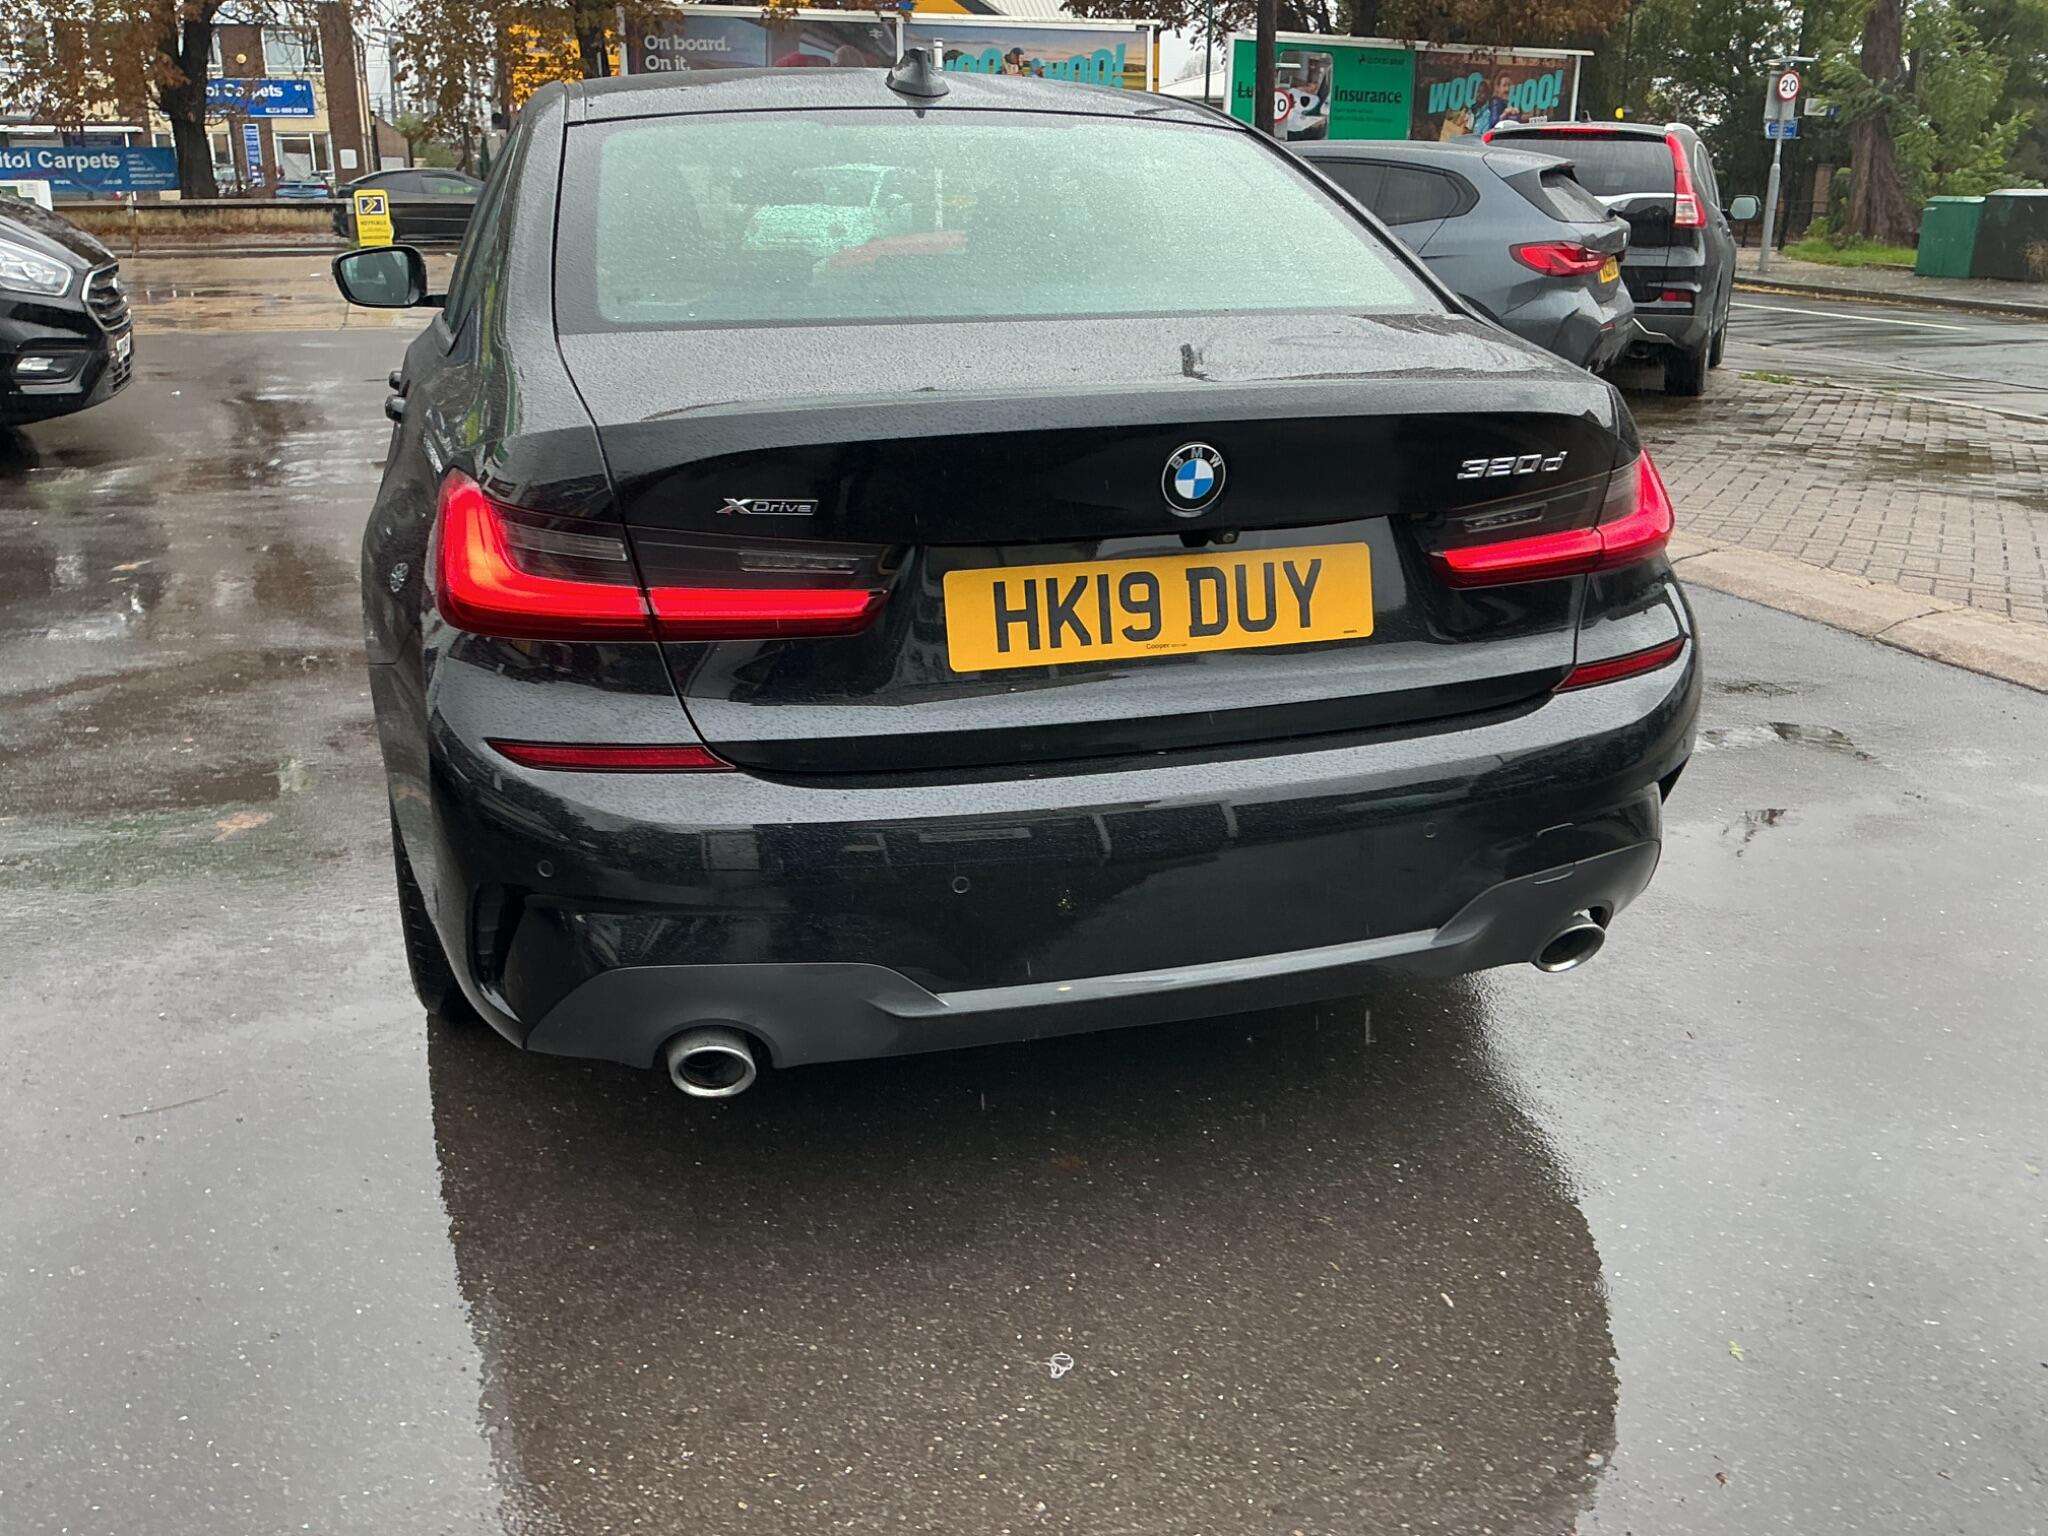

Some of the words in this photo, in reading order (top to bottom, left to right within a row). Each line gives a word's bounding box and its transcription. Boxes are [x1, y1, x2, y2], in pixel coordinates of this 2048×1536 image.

[644, 35, 670, 51] On
[673, 35, 731, 51] board.
[645, 54, 672, 71] On
[674, 55, 692, 71] it.
[1334, 84, 1403, 104] Insurance
[1428, 72, 1484, 114] WOO
[1508, 69, 1564, 113] HOO!
[1781, 80, 1797, 92] 20
[37, 151, 120, 173] Carpets
[1170, 447, 1222, 470] BMW
[1457, 451, 1568, 480] 320d
[993, 571, 1162, 652] HK19
[1186, 558, 1322, 637] DUY
